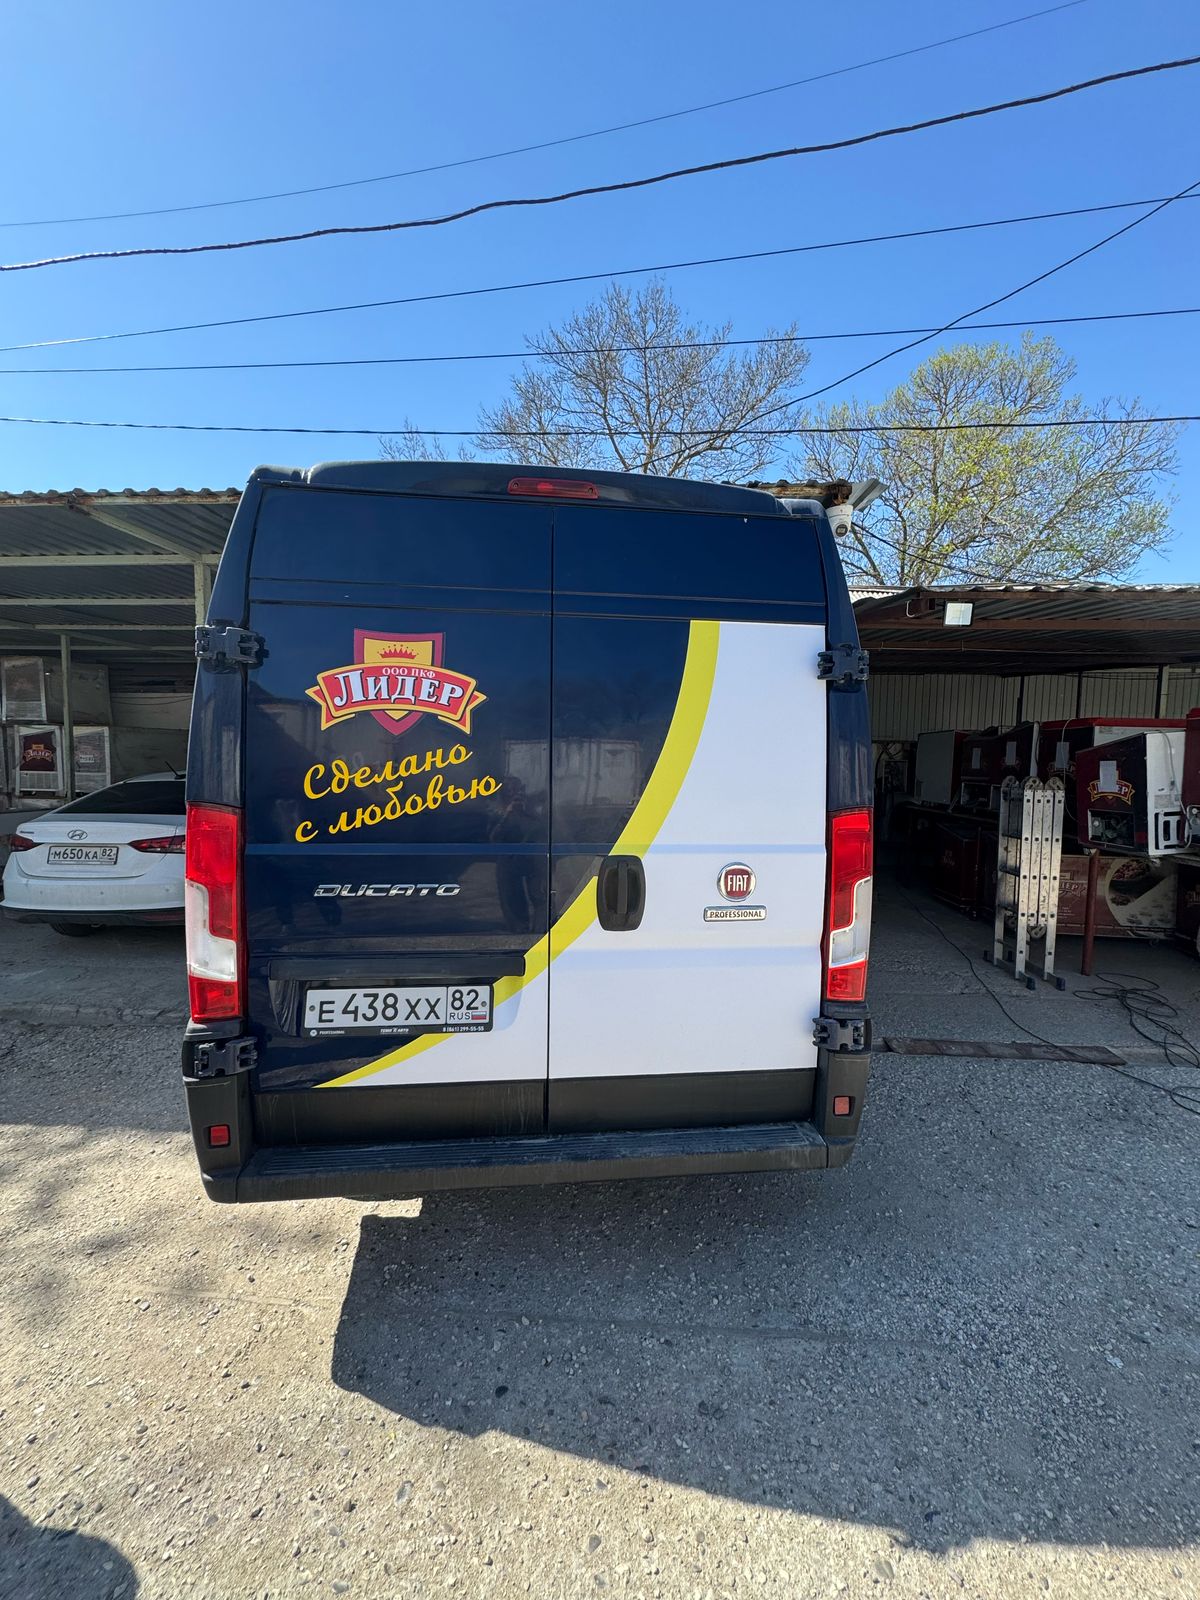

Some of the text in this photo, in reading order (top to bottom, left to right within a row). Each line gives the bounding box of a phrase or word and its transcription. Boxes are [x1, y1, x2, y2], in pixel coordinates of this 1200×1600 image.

[382, 667, 436, 679] ООО ПКФ
[303, 743, 473, 800] Сделано
[295, 774, 503, 842] с любовью
[101, 848, 113, 857] 82
[727, 875, 748, 891] FIAT
[313, 884, 461, 897] DUCATO
[709, 910, 763, 919] PROFESSIONAL
[450, 989, 480, 1011] 82
[449, 1012, 471, 1020] RUS
